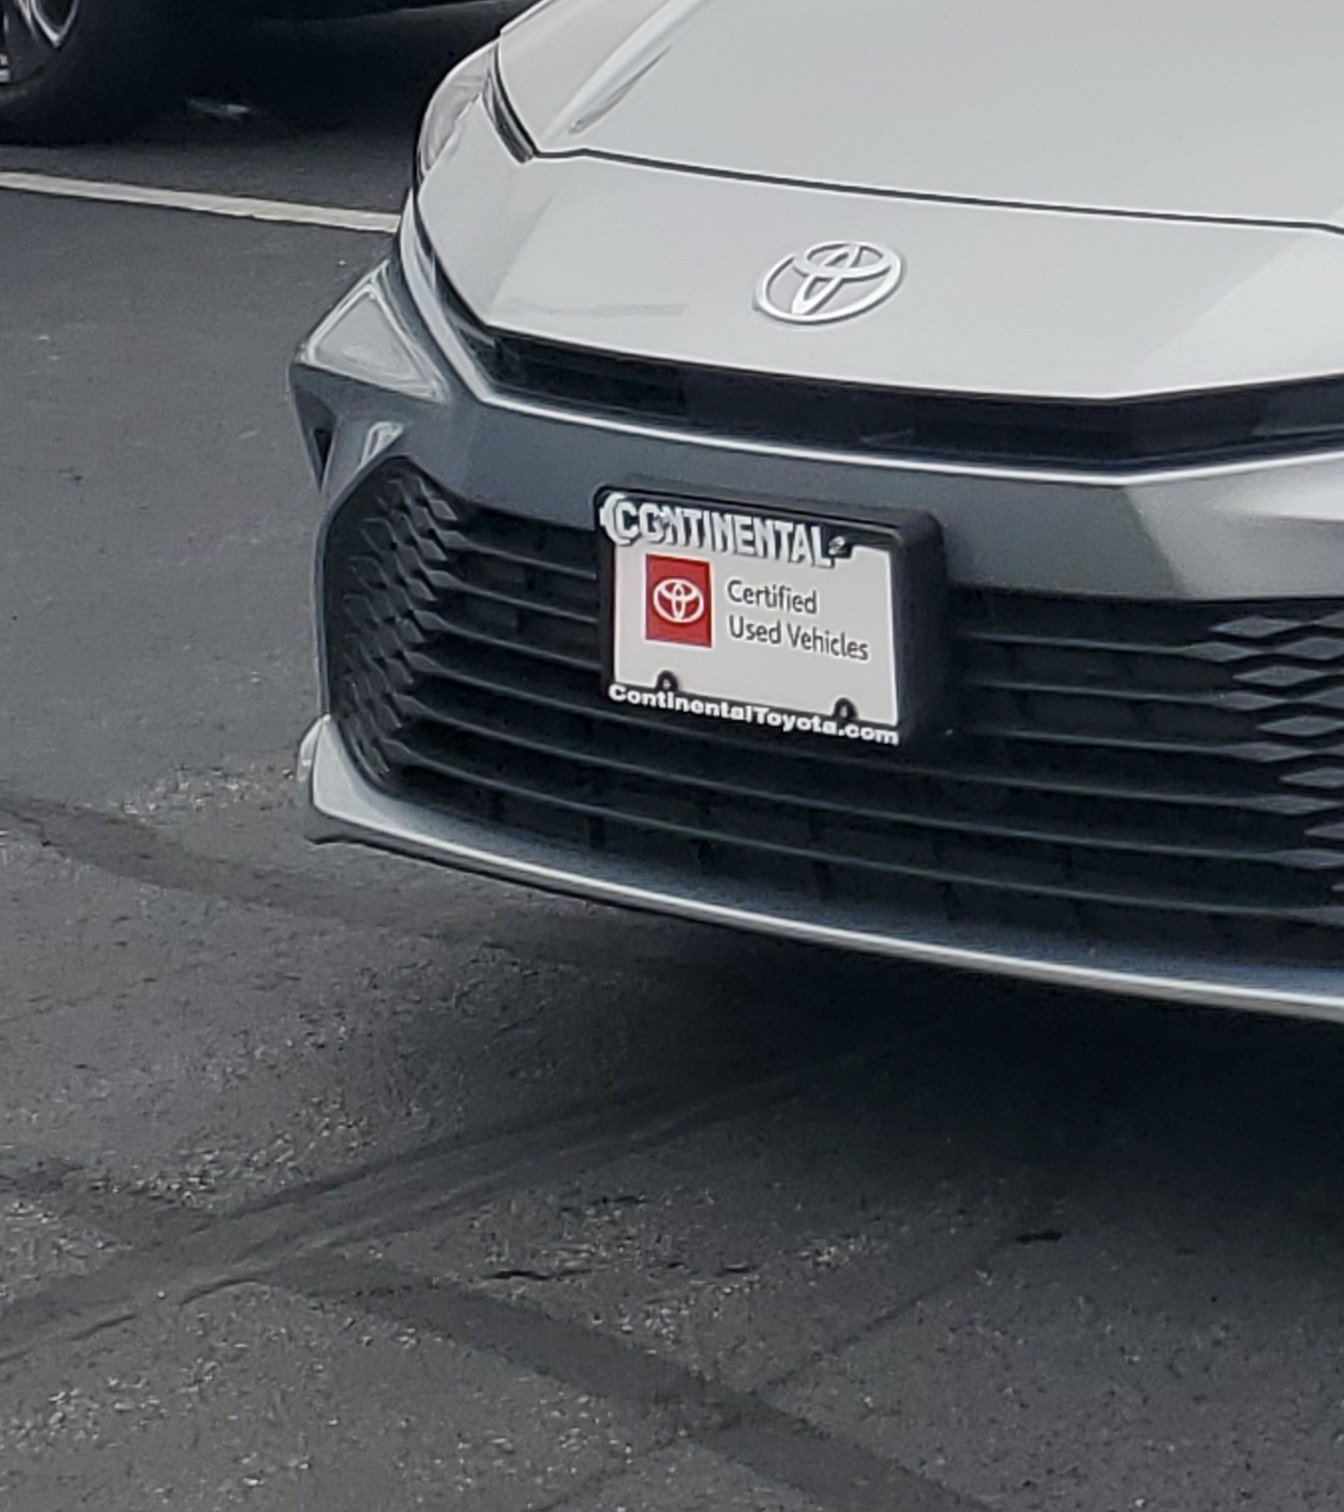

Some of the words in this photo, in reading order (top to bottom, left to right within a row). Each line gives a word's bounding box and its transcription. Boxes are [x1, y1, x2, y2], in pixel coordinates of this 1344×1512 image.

[600, 492, 835, 568] CONTINENTAL
[727, 579, 817, 615] Certified
[728, 614, 781, 645] Used
[785, 625, 869, 662] Vehicles
[608, 683, 899, 746] ContinentalToyota.com
